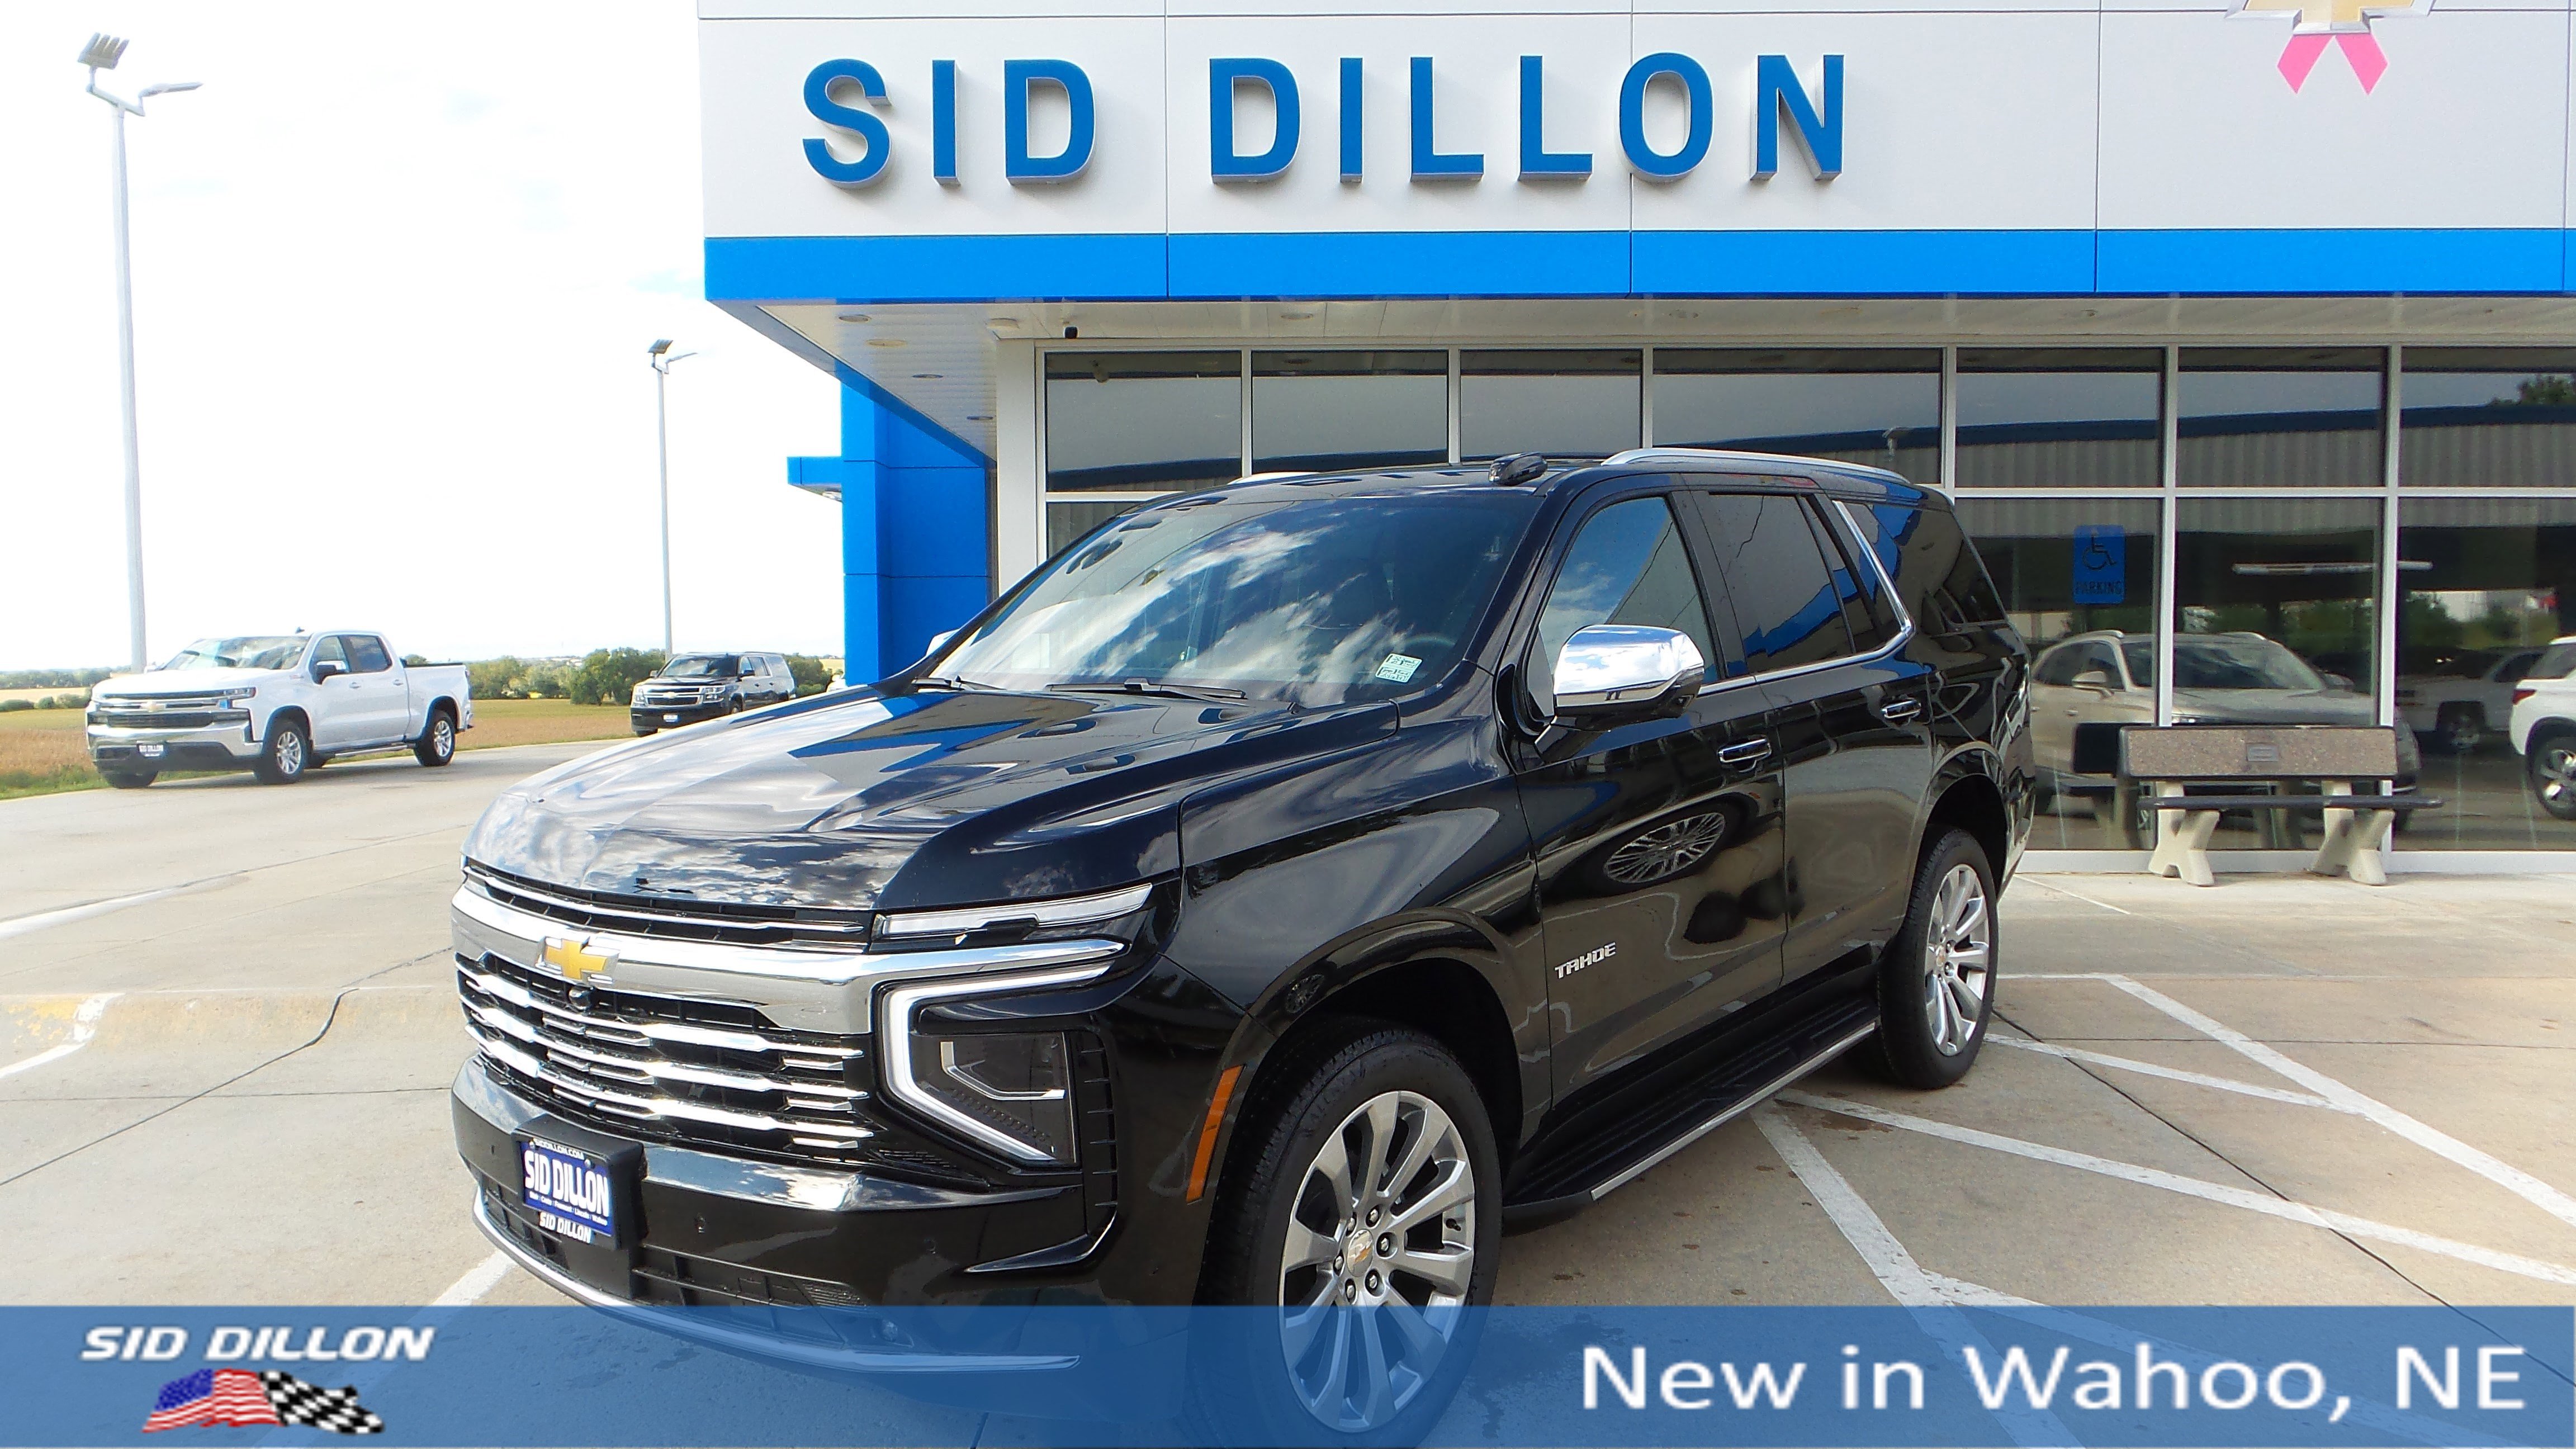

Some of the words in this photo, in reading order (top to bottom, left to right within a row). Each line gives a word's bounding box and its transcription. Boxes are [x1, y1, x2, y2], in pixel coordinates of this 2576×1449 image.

[803, 58, 1096, 186] SID
[1209, 51, 1845, 183] DILLON
[1554, 942, 1616, 979] TAHOE
[524, 1150, 551, 1195] SID
[552, 1159, 609, 1217] DILLON
[539, 1213, 555, 1231] SID
[557, 1217, 591, 1243] DILLON
